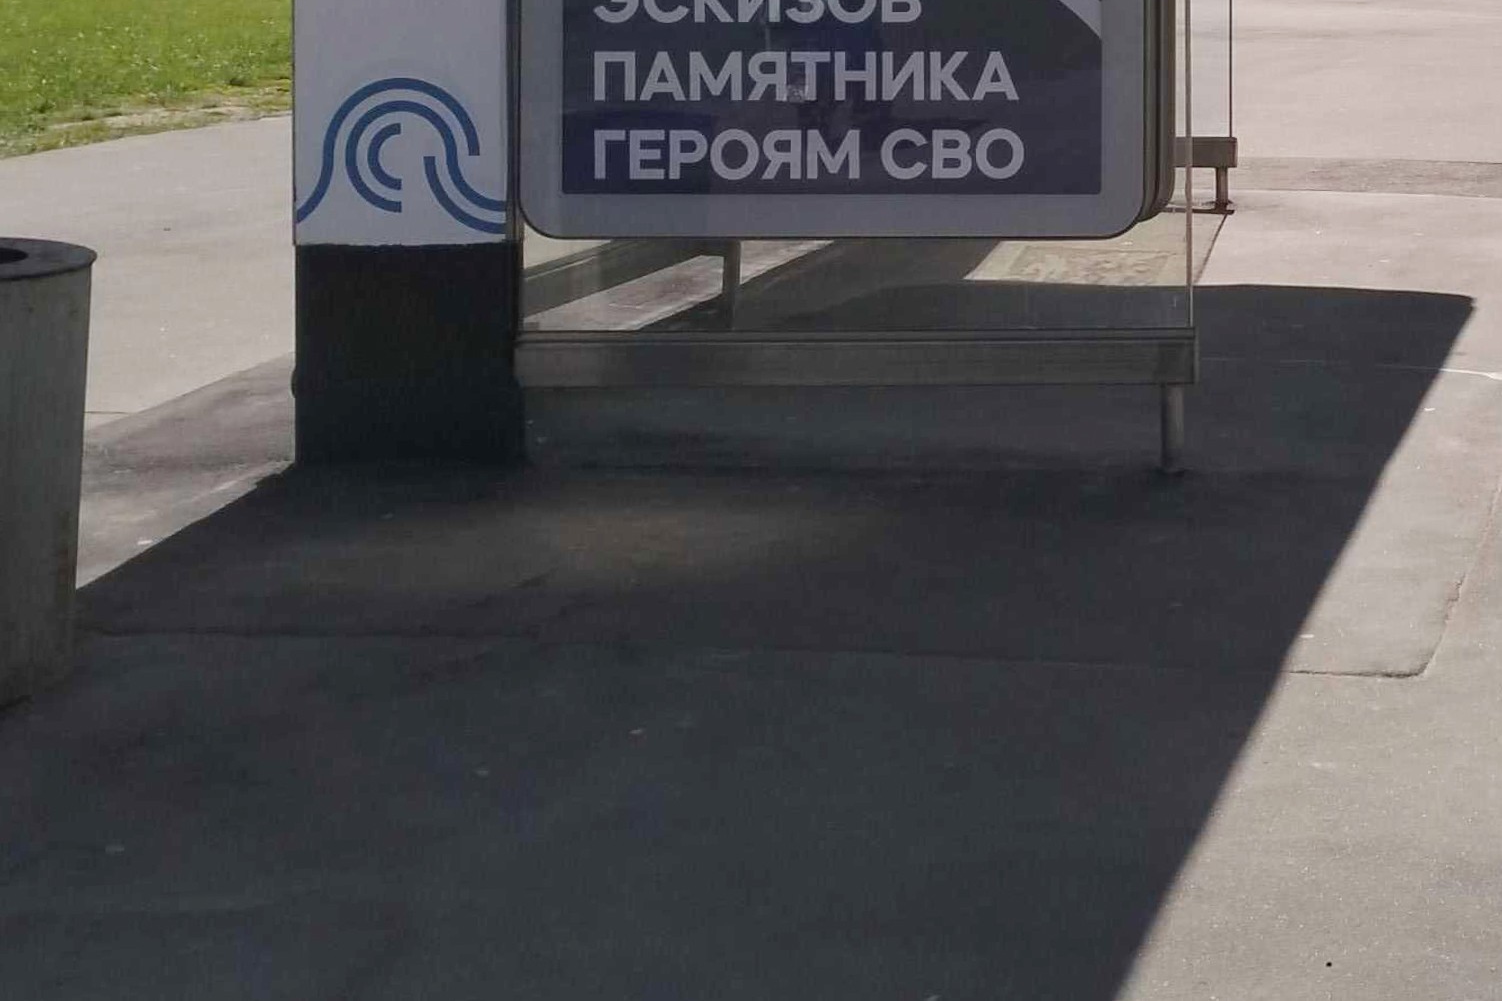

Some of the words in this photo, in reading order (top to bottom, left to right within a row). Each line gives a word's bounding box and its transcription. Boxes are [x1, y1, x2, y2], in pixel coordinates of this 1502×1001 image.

[593, 50, 1020, 102] ПАМЯТНИКА
[593, 128, 861, 181] ГЕРОЯМ
[880, 128, 1026, 181] СВО
